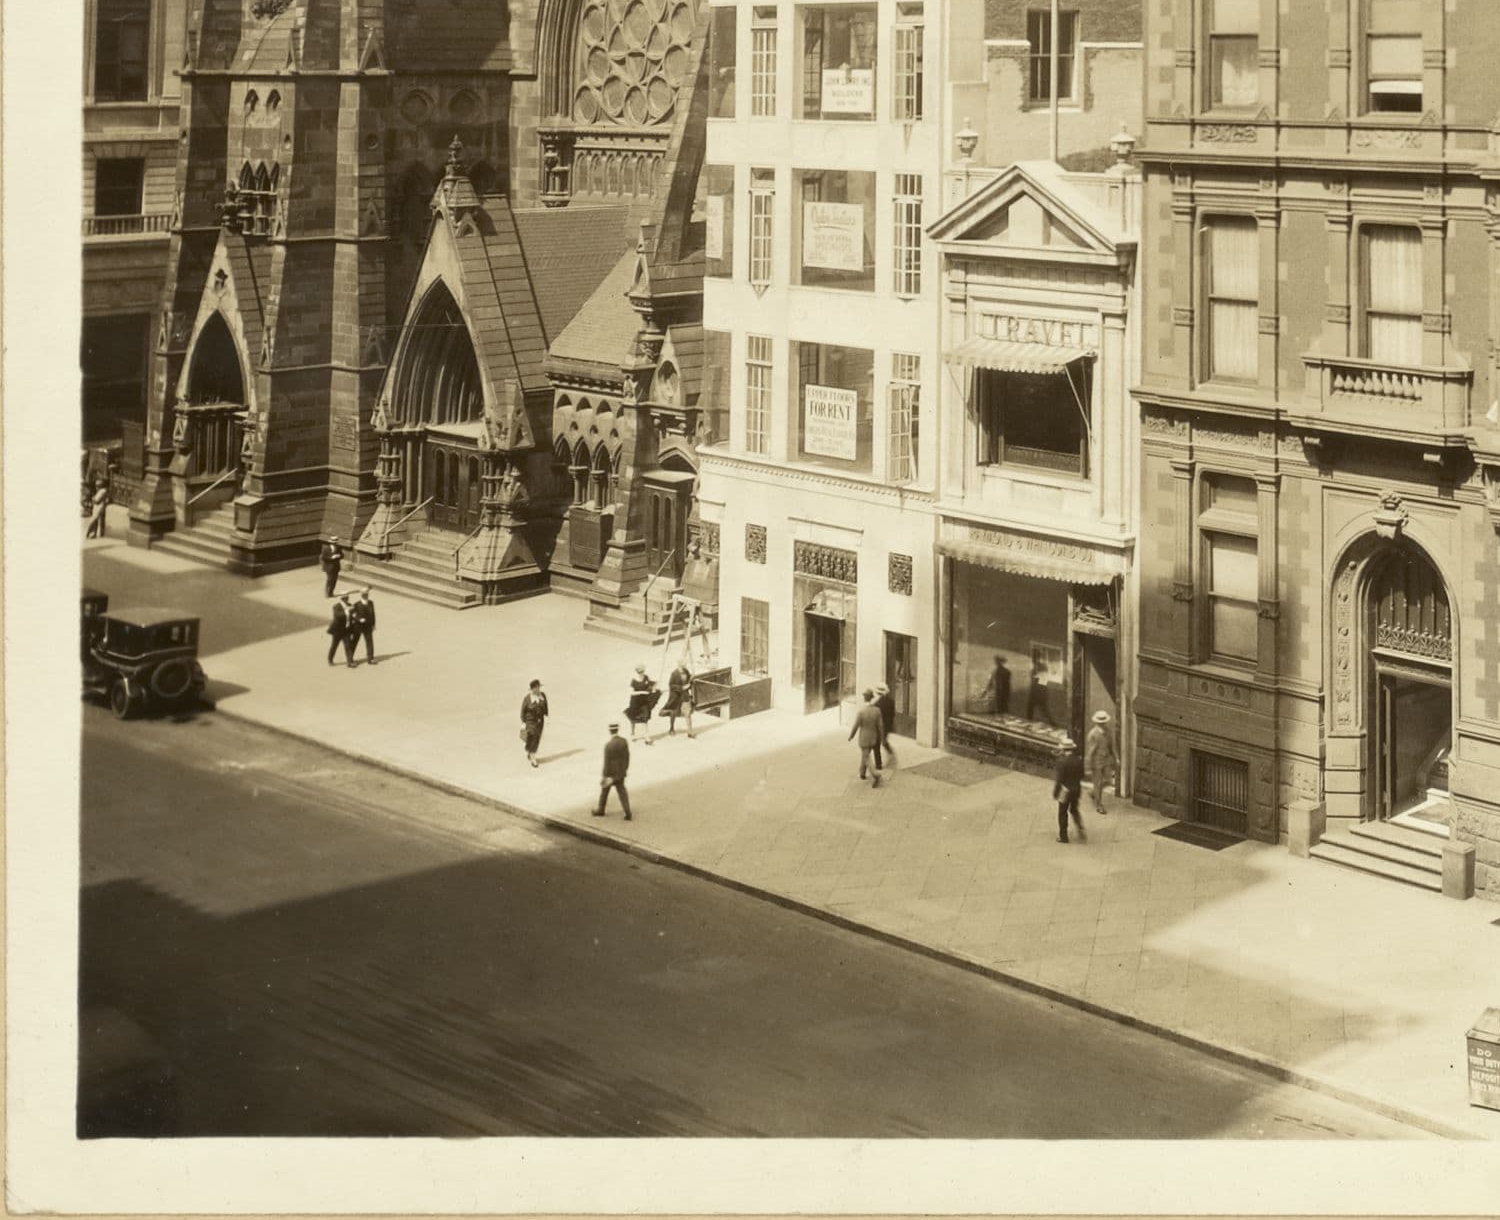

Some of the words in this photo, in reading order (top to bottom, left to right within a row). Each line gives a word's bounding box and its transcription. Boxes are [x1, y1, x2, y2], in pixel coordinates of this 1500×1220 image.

[981, 312, 1095, 349] TRAVEL
[810, 400, 827, 417] FOR
[828, 402, 851, 421] RENT
[1476, 1047, 1492, 1058] DO
[1485, 1058, 1500, 1069] DUTY
[1471, 1069, 1500, 1084] DEPOSIT
